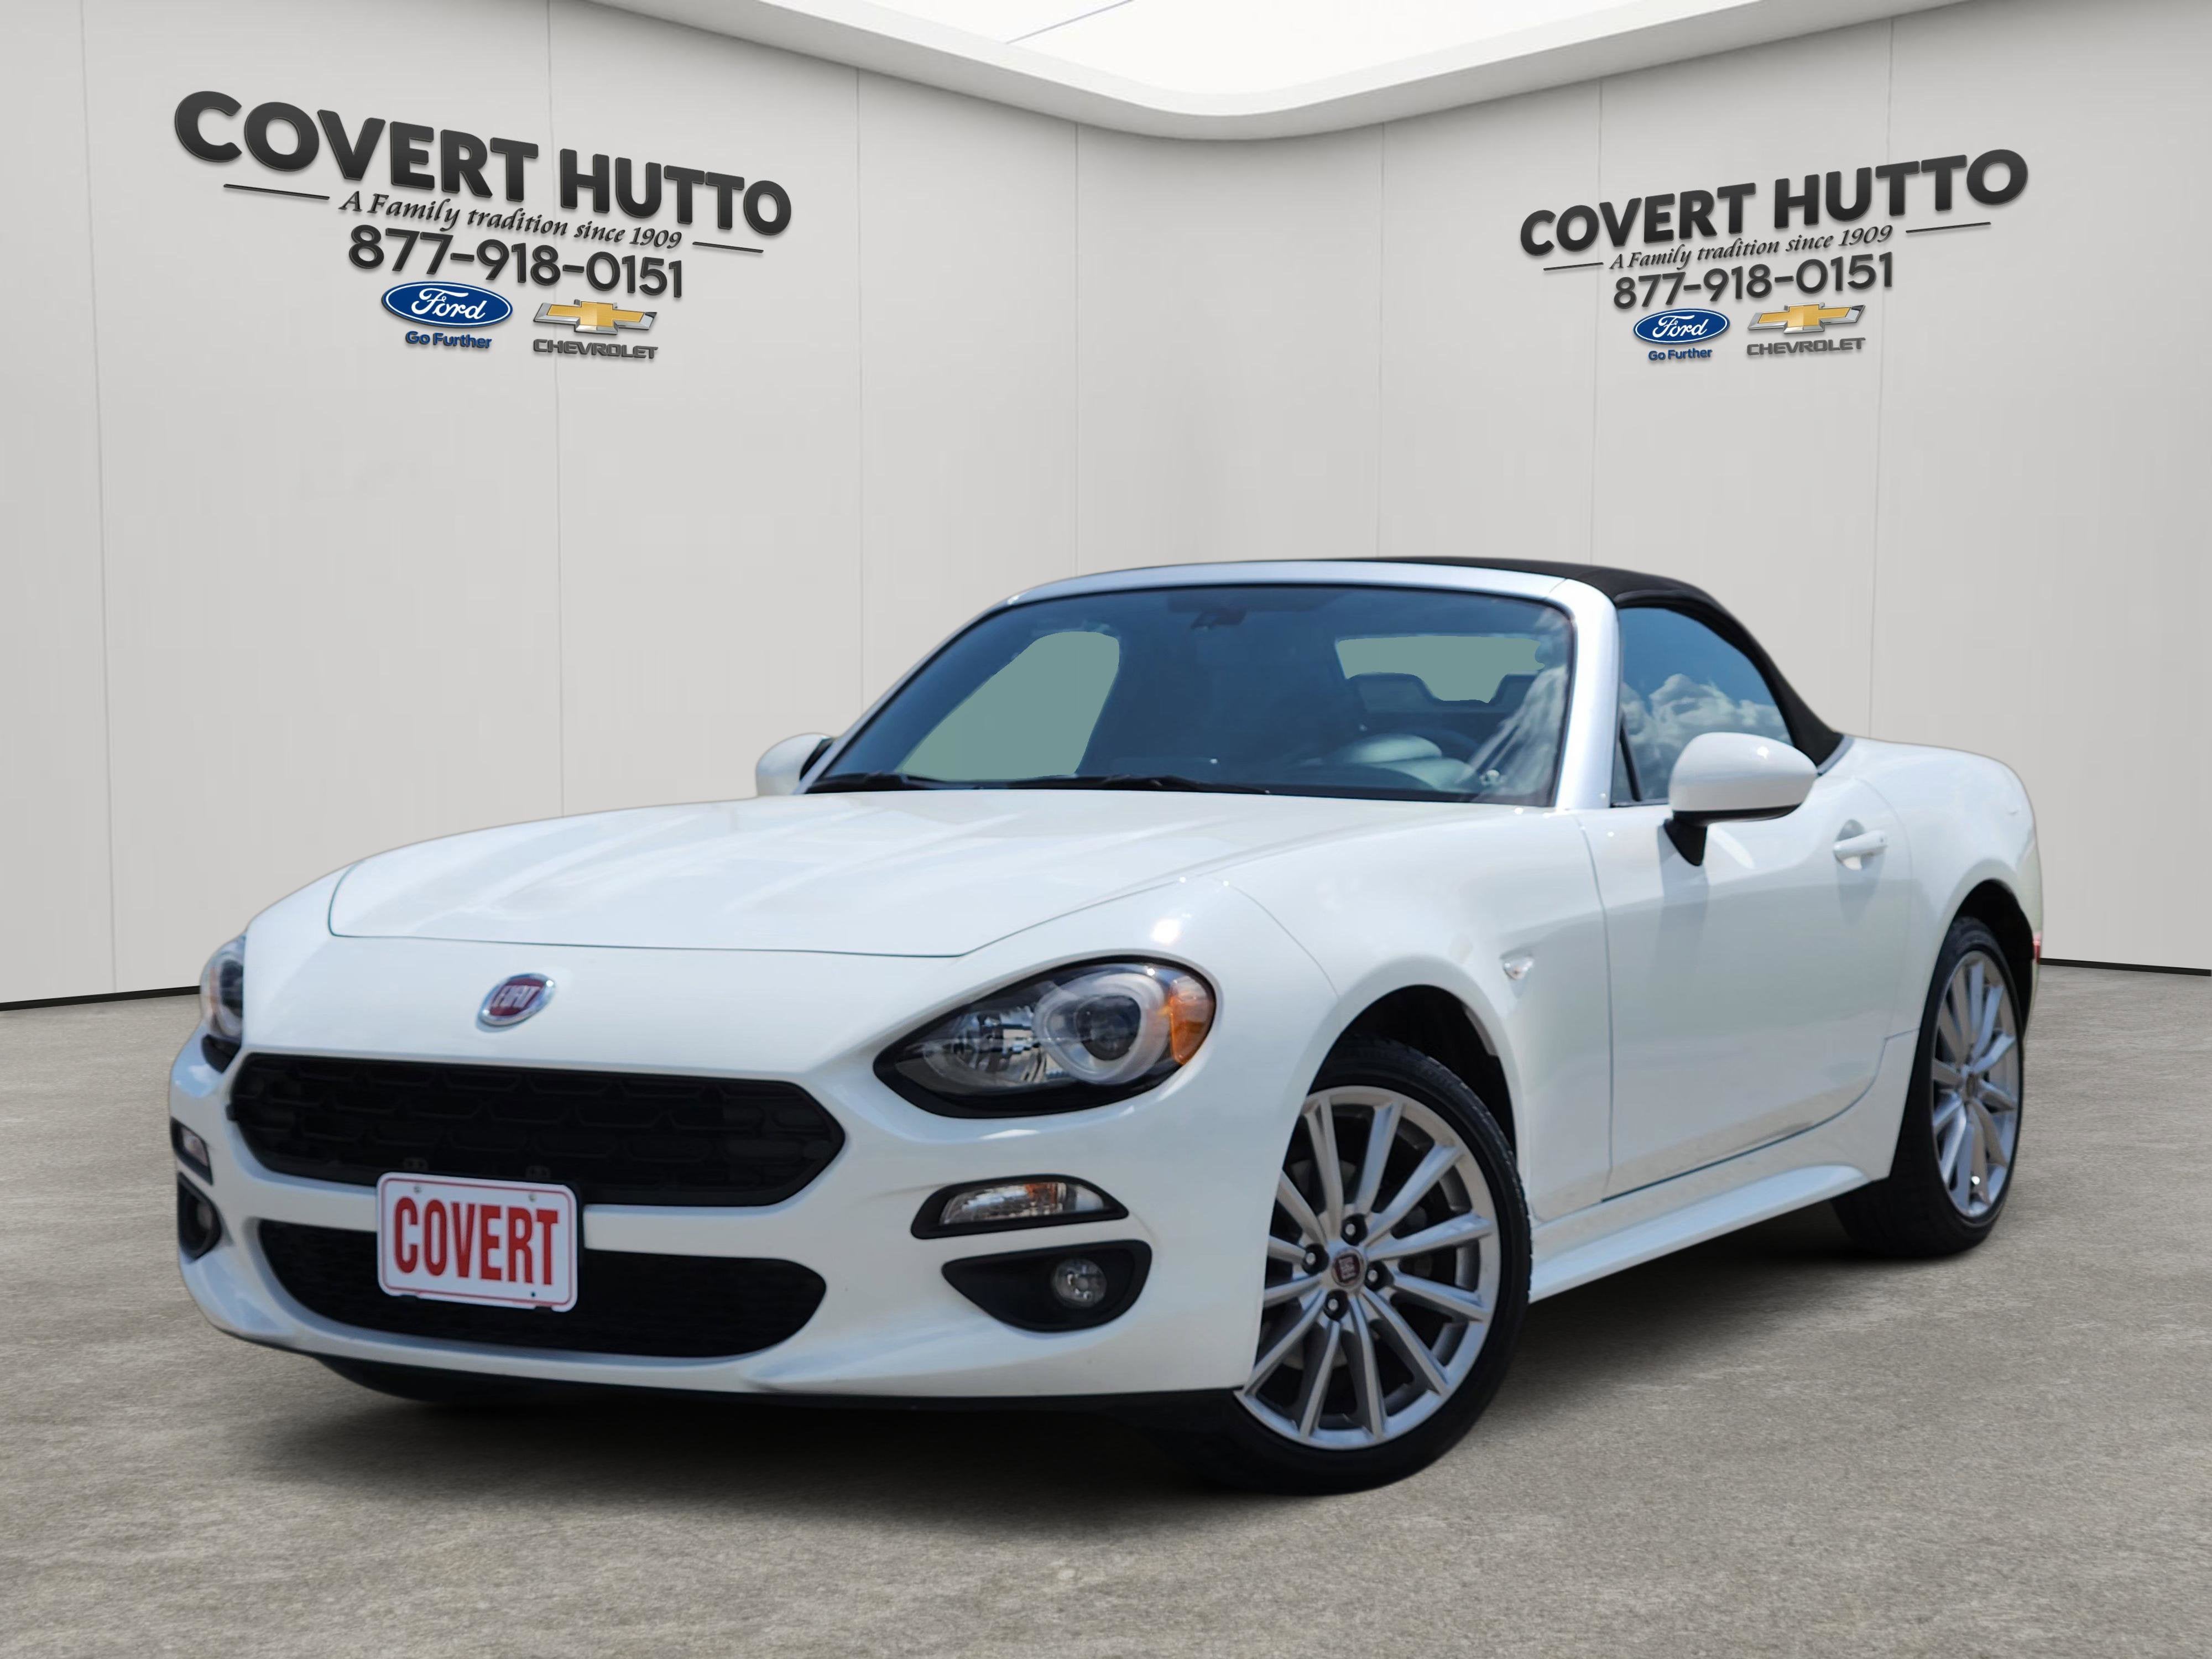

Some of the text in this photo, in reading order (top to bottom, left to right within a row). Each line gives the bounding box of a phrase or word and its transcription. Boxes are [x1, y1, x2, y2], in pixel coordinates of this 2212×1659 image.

[174, 90, 792, 236] COVERT HUTTO
[338, 190, 682, 249] A Family tradition since 1909
[1520, 149, 2029, 256] COVERT HUTTO
[348, 224, 682, 298] 877-918-0151
[1609, 225, 1893, 270] A Family tradition since 1909
[1613, 251, 1893, 309] 877-918-0151
[410, 287, 488, 320] Ford
[405, 331, 493, 349] Go Further
[533, 338, 659, 359] CHEVROLET
[1652, 315, 1709, 338] Ford
[1746, 337, 1866, 356] CHEVROLET
[1648, 348, 1713, 361] Go Further
[394, 1196, 560, 1286] COVERT
